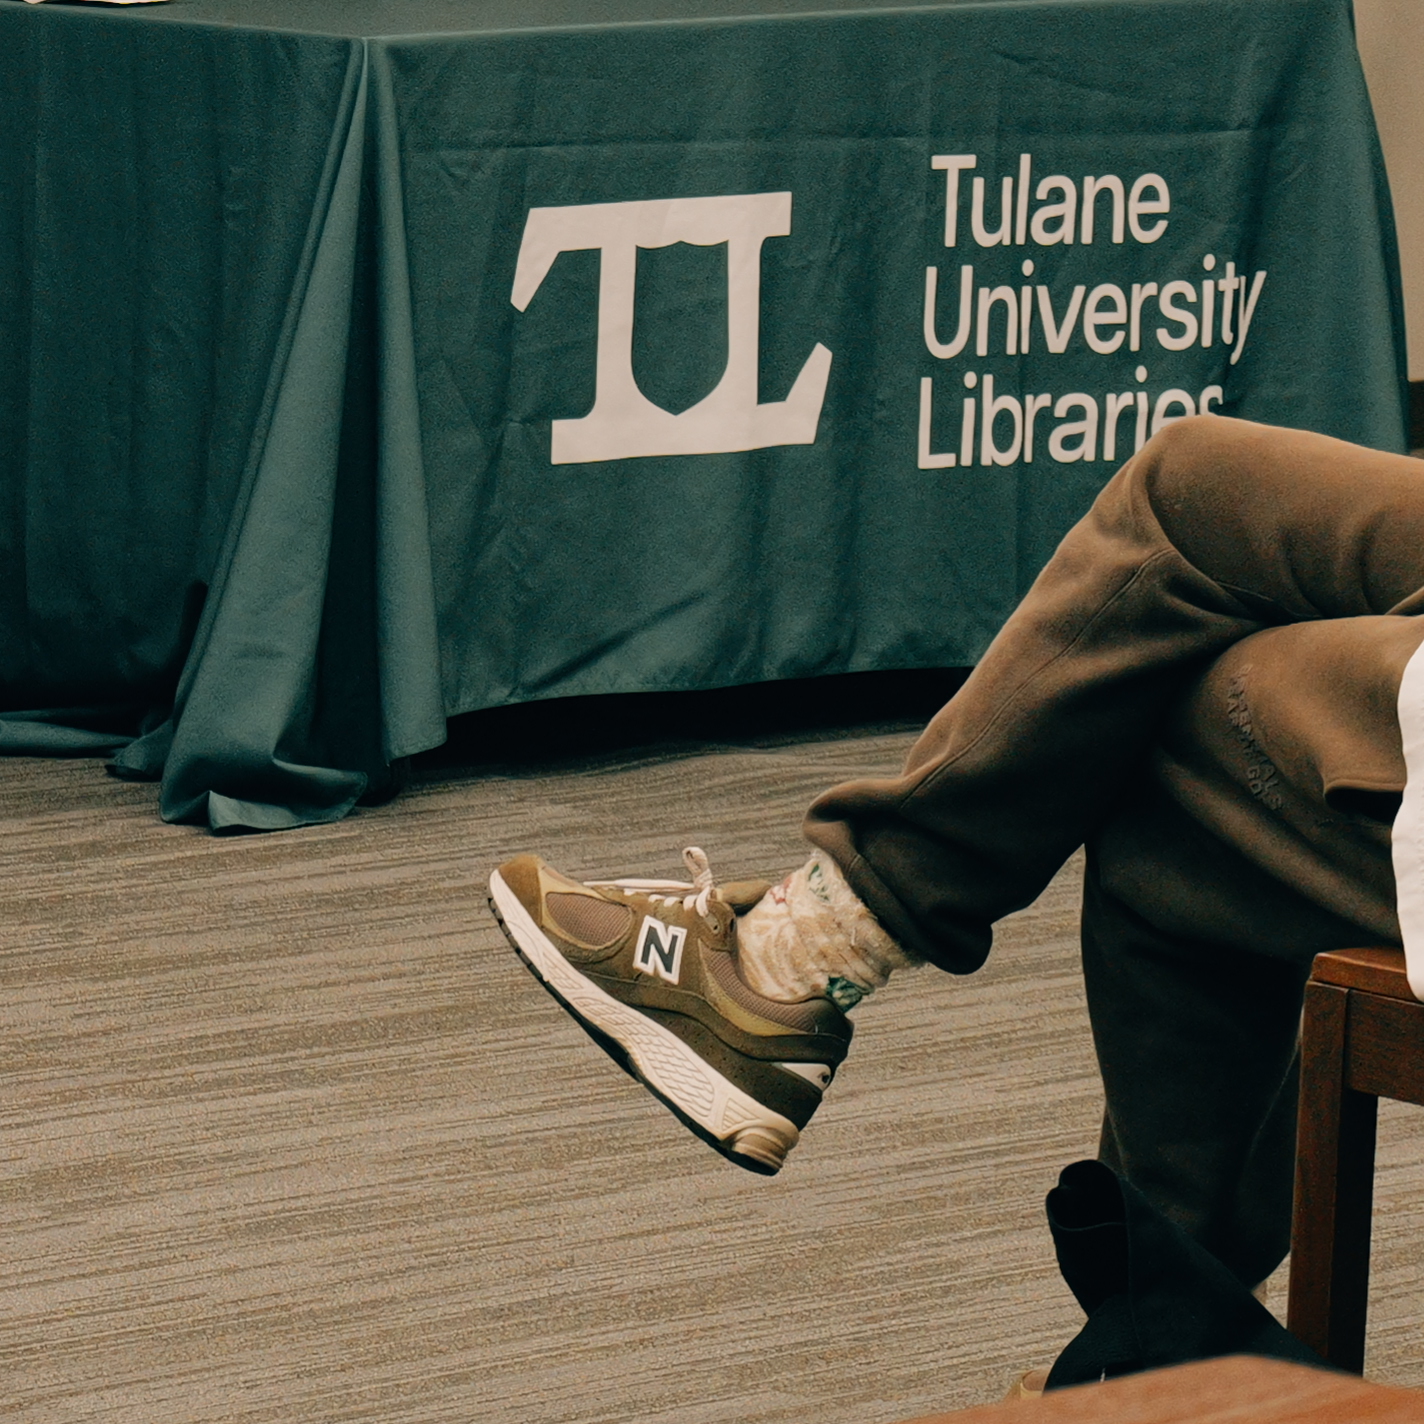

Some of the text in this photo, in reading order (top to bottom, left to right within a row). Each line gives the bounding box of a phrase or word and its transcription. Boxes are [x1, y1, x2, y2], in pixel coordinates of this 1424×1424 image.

[930, 153, 1171, 249] Tulane
[922, 253, 1267, 365] University
[633, 914, 688, 986] N
